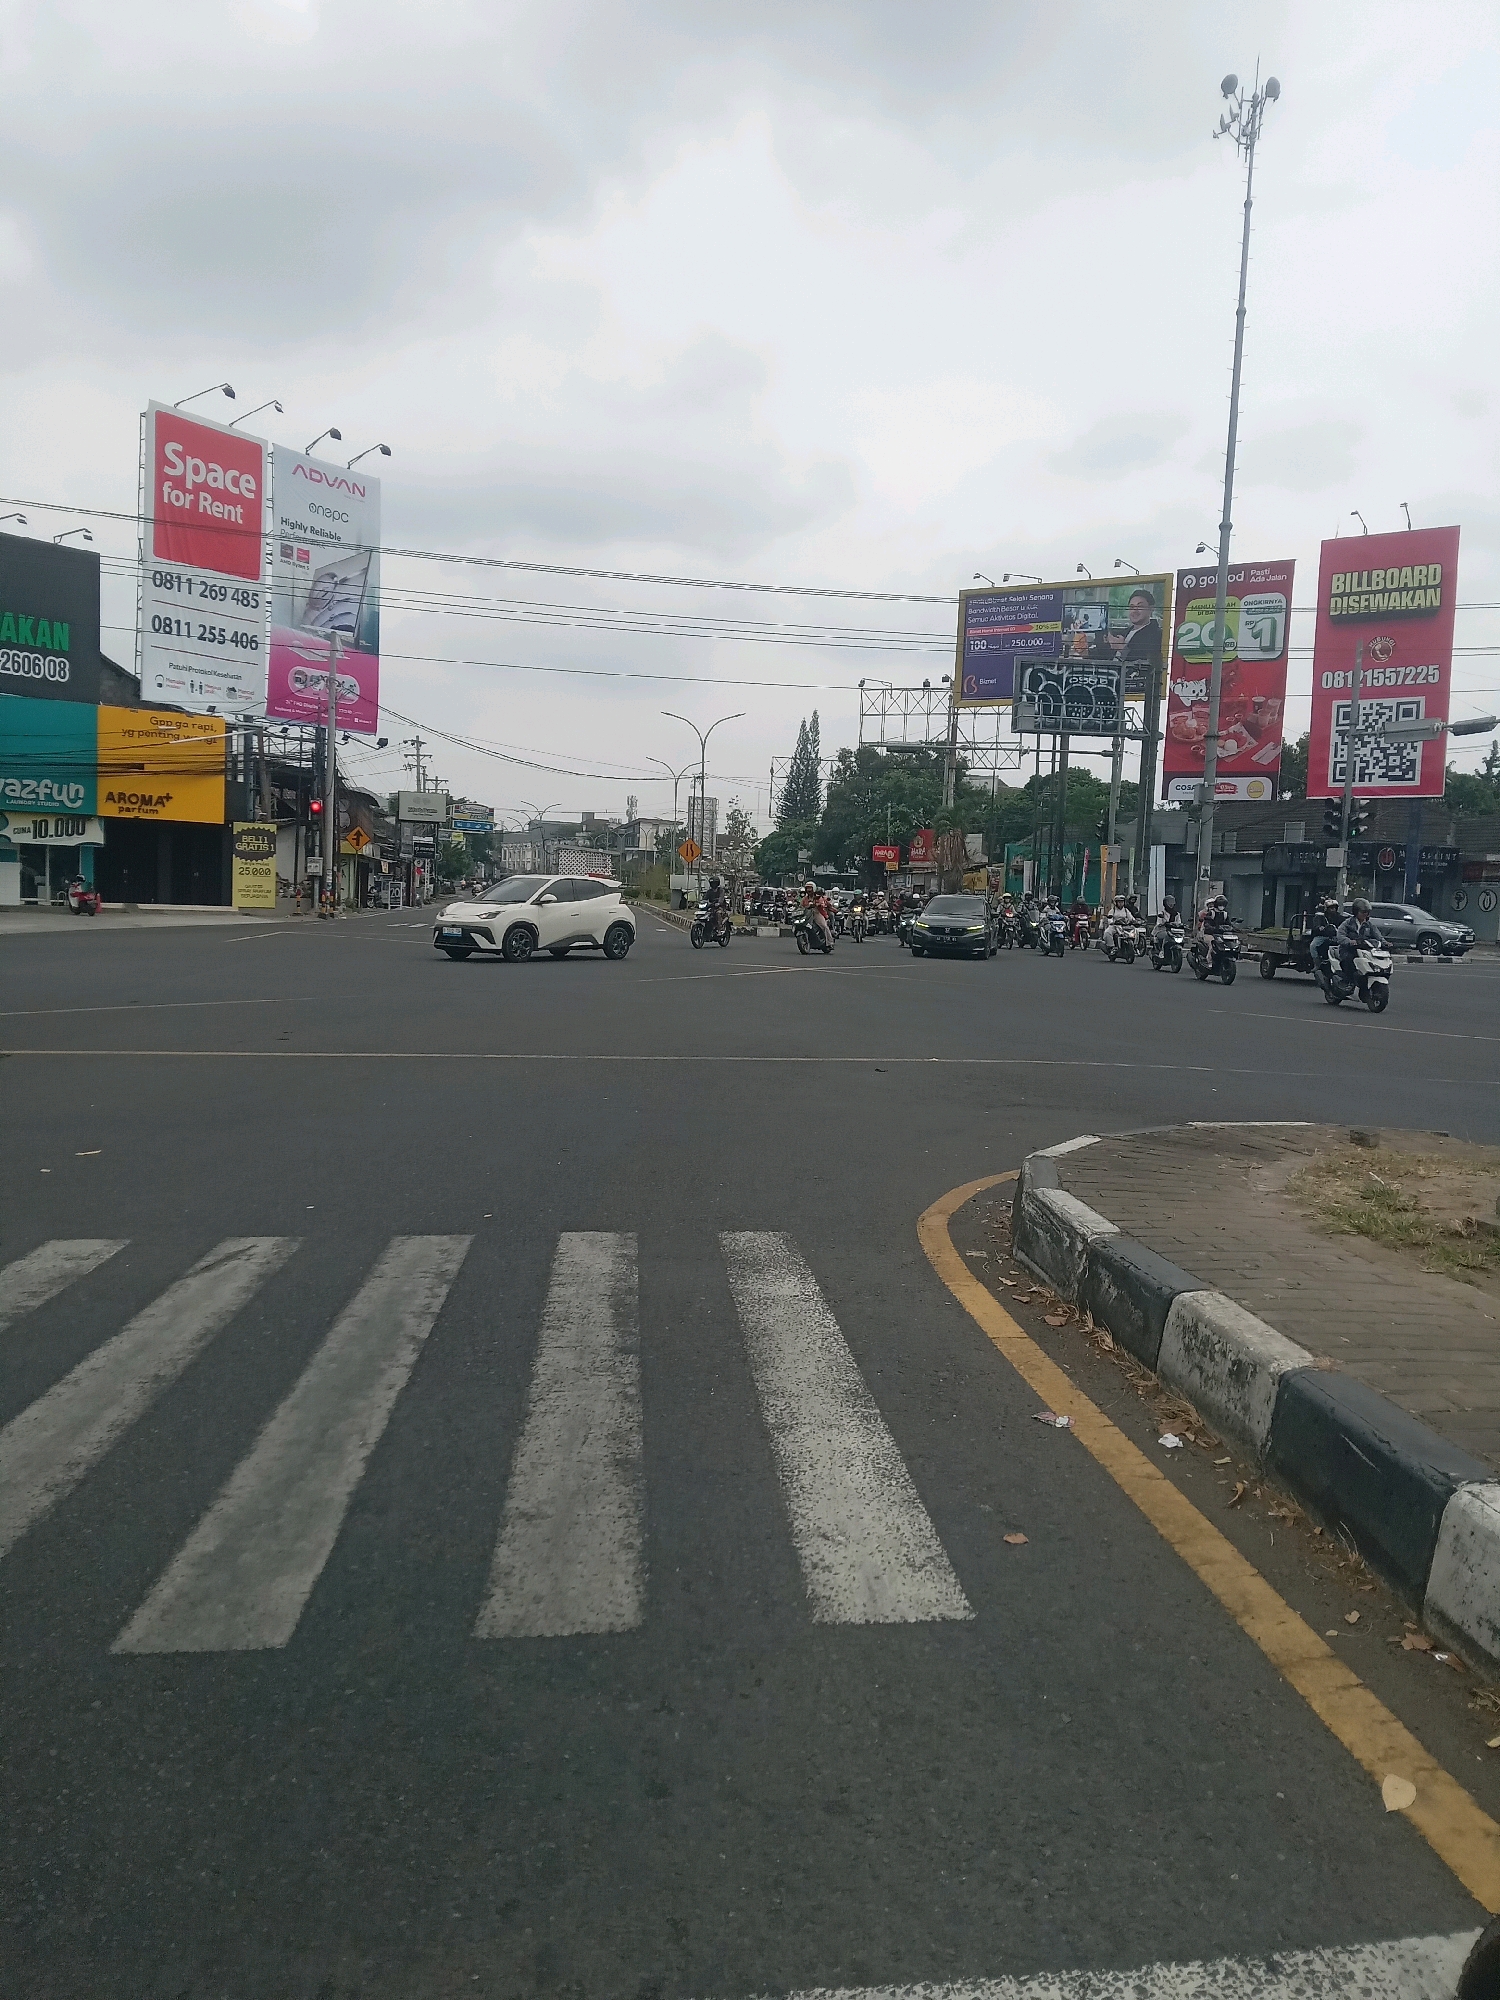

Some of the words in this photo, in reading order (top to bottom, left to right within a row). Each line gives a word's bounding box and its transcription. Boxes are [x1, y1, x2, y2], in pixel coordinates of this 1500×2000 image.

[164, 442, 256, 498] Space
[291, 464, 365, 497] ADVAN
[163, 481, 194, 509] for
[199, 492, 243, 524] Rent
[281, 517, 308, 533] Highly
[310, 526, 341, 541] Reliable
[1249, 575, 1266, 583] Ada
[1266, 573, 1288, 582] Jalan
[1250, 568, 1271, 577] Pasti
[1331, 563, 1442, 594] BILLBOARD
[152, 571, 192, 595] 0811
[199, 581, 227, 602] 269
[231, 588, 260, 609] 485
[1329, 587, 1441, 616] DISEWAKAN
[151, 614, 191, 639] 0811
[197, 624, 226, 645] 255
[230, 631, 259, 651] 406
[1011, 637, 1044, 647] 250.000
[1252, 617, 1277, 652] 1
[1369, 636, 1396, 648] HUBUNGI
[138, 729, 180, 742] penting
[118, 805, 159, 815] parfum
[32, 818, 87, 840] 10.000
[235, 843, 270, 851] GRATIS
[238, 866, 272, 877] 25.000
[389, 887, 401, 898] 20
